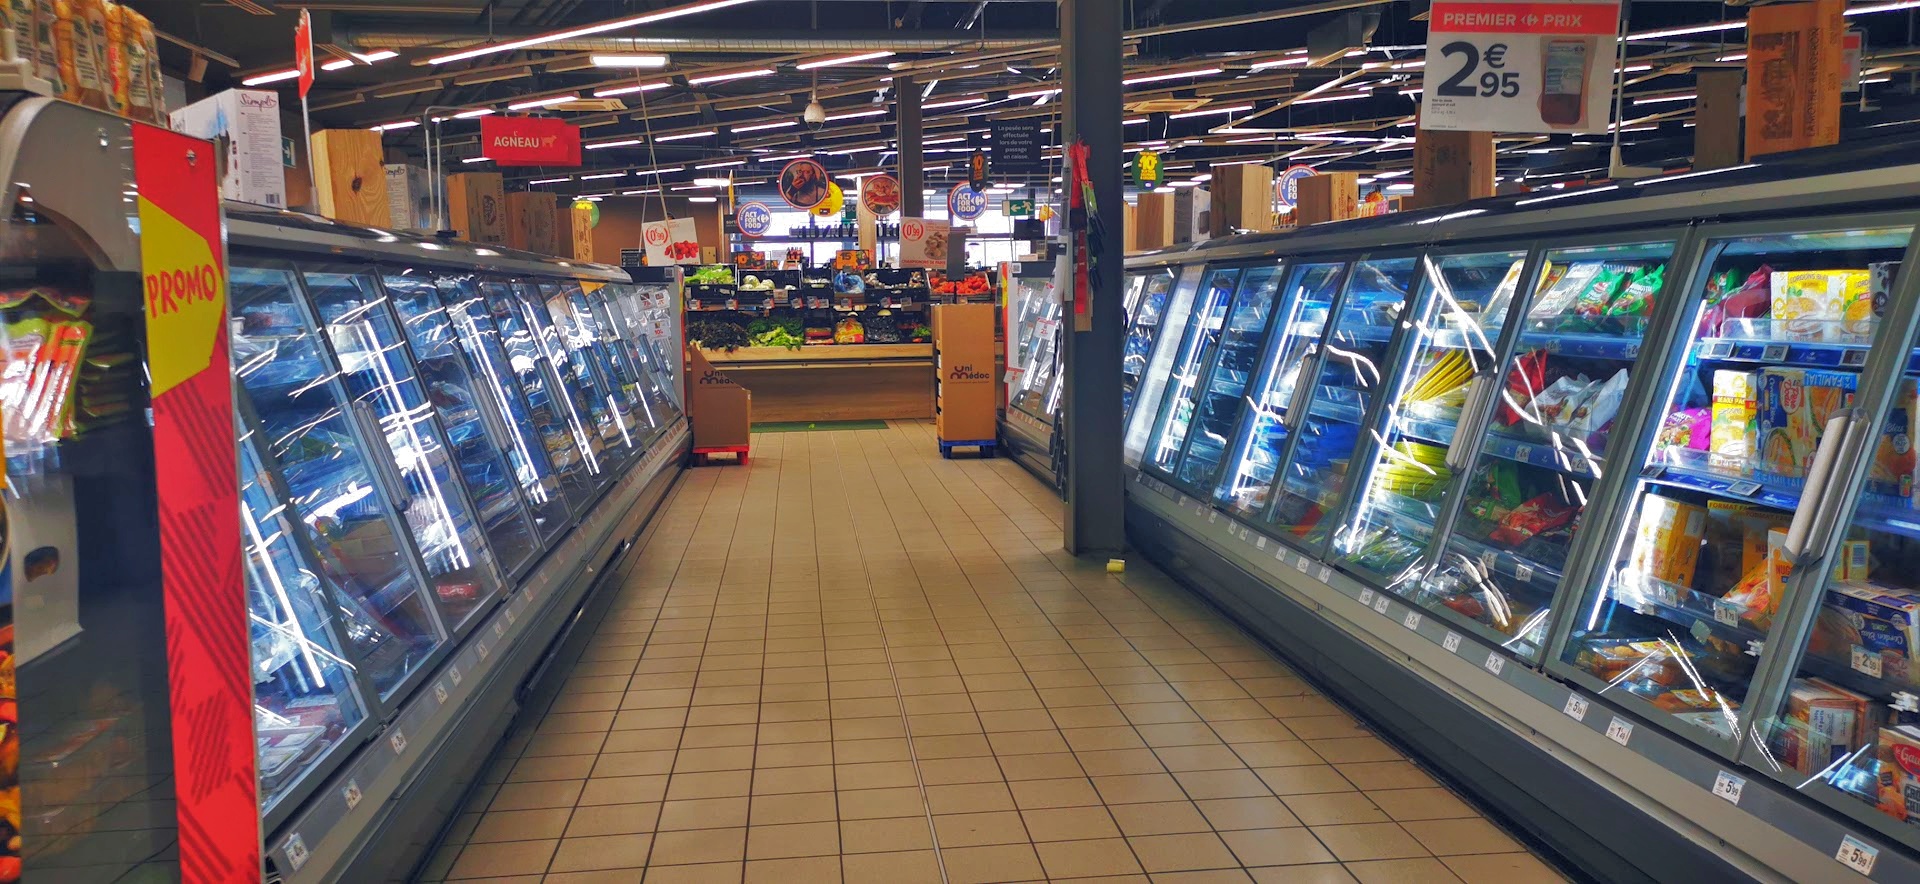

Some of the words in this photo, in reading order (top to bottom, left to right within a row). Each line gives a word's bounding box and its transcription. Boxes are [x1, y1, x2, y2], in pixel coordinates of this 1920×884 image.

[1443, 13, 1516, 26] PREMIER
[1543, 14, 1583, 27] PRIX
[494, 136, 539, 148] AGNEAU
[146, 265, 216, 319] PROMO
[1709, 502, 1737, 510] FORMAT
